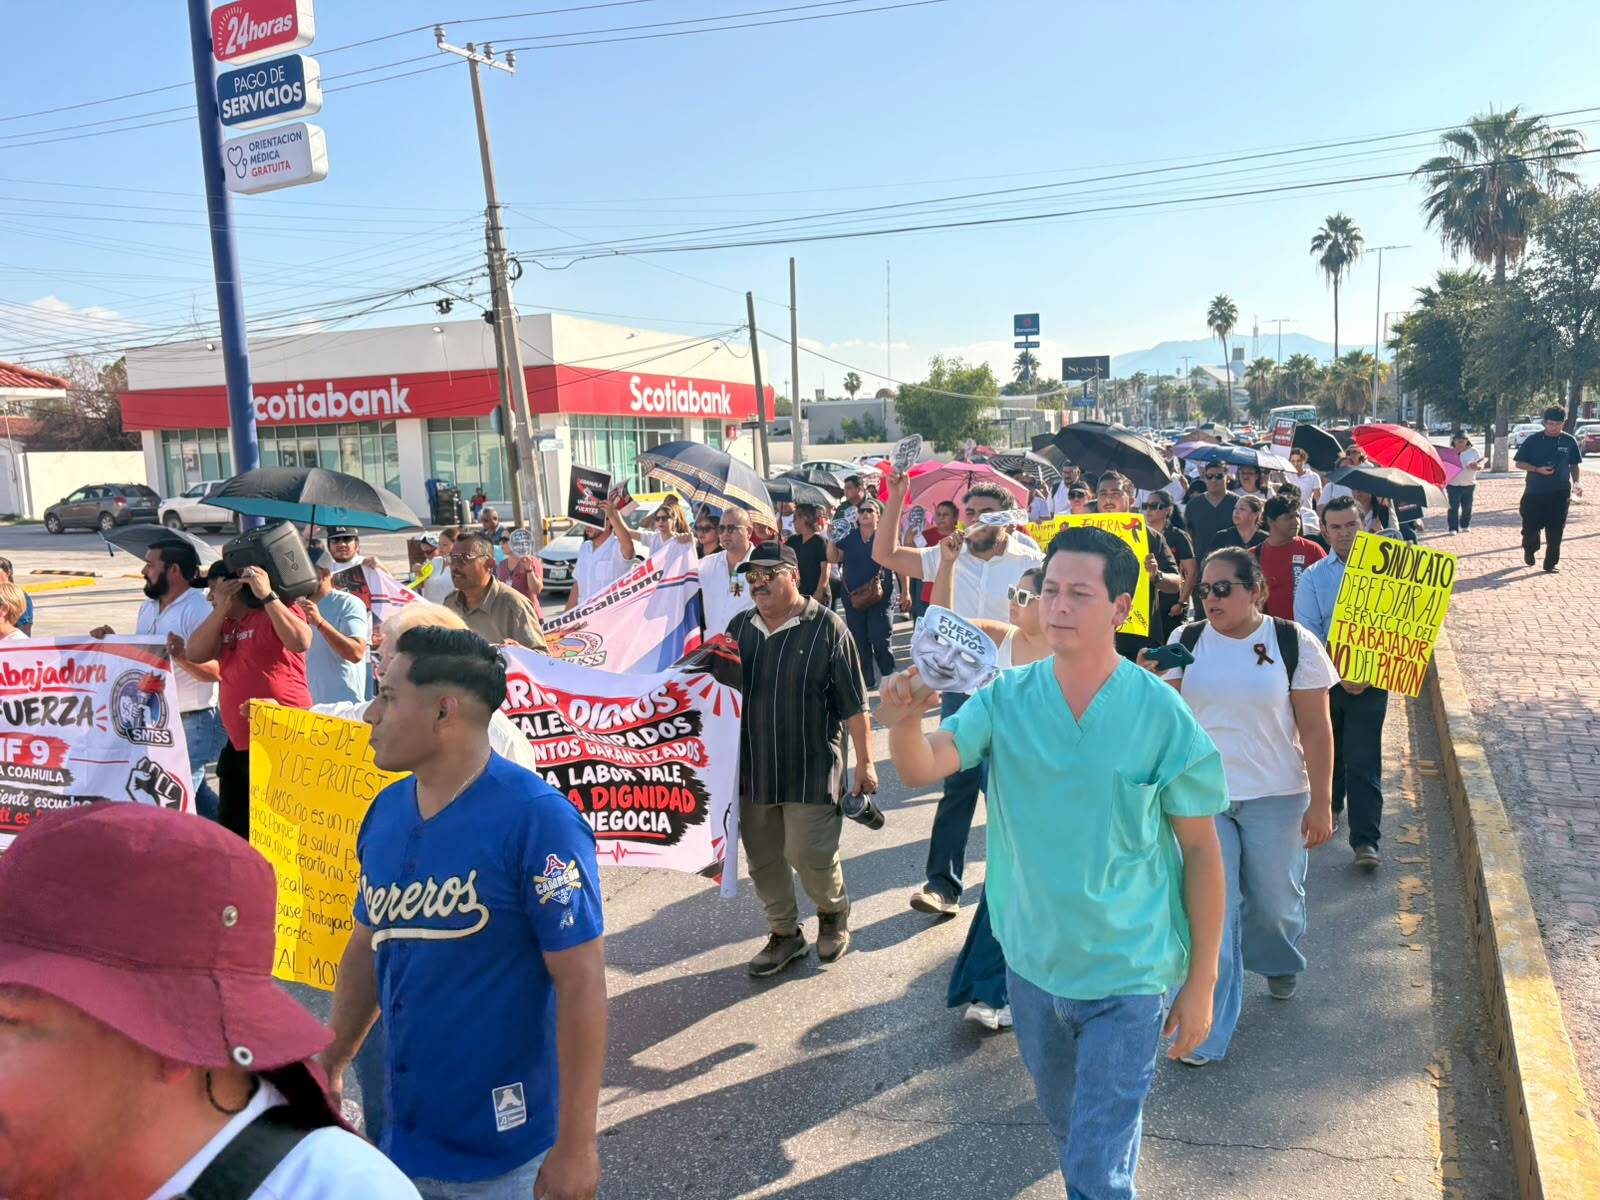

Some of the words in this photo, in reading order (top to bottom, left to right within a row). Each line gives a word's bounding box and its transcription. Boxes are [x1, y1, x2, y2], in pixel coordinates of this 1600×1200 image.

[234, 70, 267, 93] PAGO
[270, 65, 285, 84] DE
[222, 81, 303, 119] SERVICIOS
[250, 149, 281, 165] MÉDICA
[252, 159, 291, 178] GRATUITA
[254, 377, 412, 421] cotiabank
[629, 375, 732, 415] Scotiabank
[1347, 535, 1369, 570] EL
[1372, 541, 1454, 589] SINDICATO
[1337, 572, 1378, 612] DEBE
[1374, 578, 1422, 623] ESTAR
[1415, 590, 1443, 628] AL
[939, 615, 983, 644] FUERA
[1344, 607, 1412, 636] SERVICIO
[1415, 626, 1434, 643] DEL
[938, 625, 986, 656] OLIVOS
[1336, 620, 1429, 663] TRABAJADOR
[1375, 653, 1427, 695] PATRON
[0, 695, 94, 728] UERZA
[132, 728, 171, 744] SNTSS
[310, 716, 333, 747] ES
[336, 722, 361, 757] DE
[580, 717, 693, 748] UIPADOS
[30, 740, 51, 766] 9
[585, 740, 700, 765] GARANTIZADOS
[7, 766, 65, 783] COAHUILA
[291, 754, 314, 787] DE
[536, 771, 561, 788] A
[568, 764, 636, 786] LABOR
[637, 764, 686, 787] VALE,
[591, 784, 696, 814] DIGNIDAD
[15, 812, 31, 825] es
[310, 834, 340, 857] salud
[277, 948, 305, 975] AL
